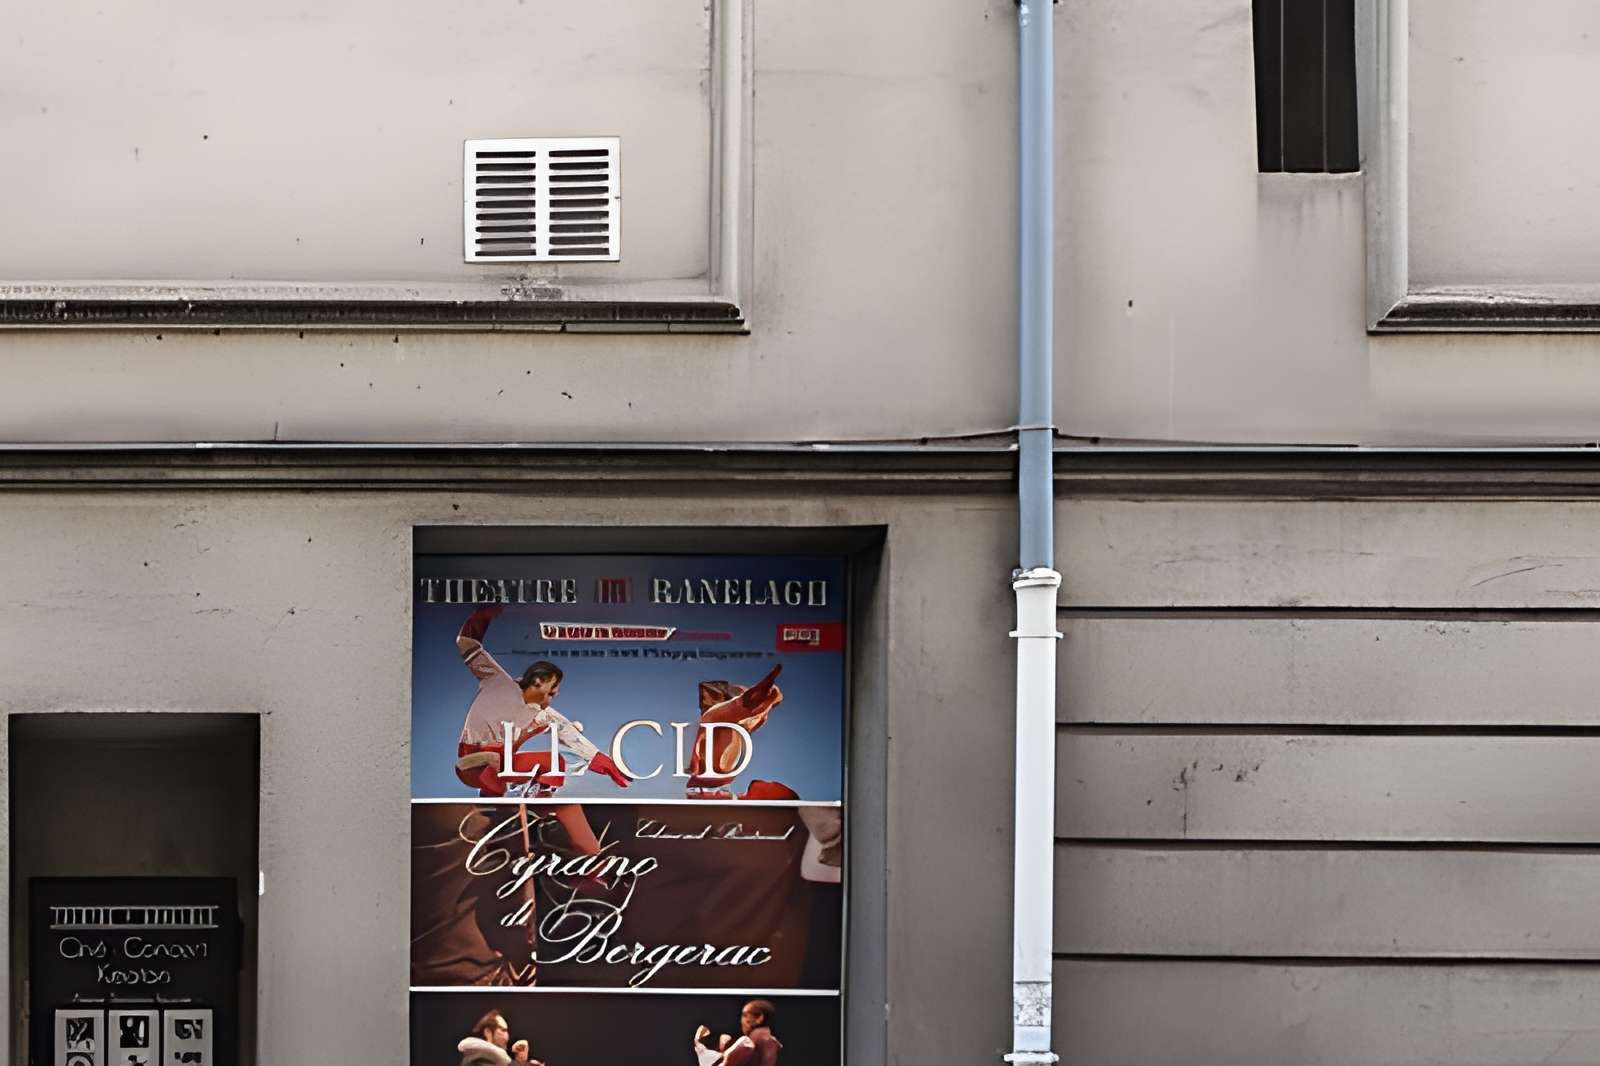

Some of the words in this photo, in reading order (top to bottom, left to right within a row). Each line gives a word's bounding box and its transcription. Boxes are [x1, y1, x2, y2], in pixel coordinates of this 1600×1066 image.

[610, 719, 754, 780] CID
[459, 807, 658, 899] Cyrano
[532, 898, 772, 988] Bergerac
